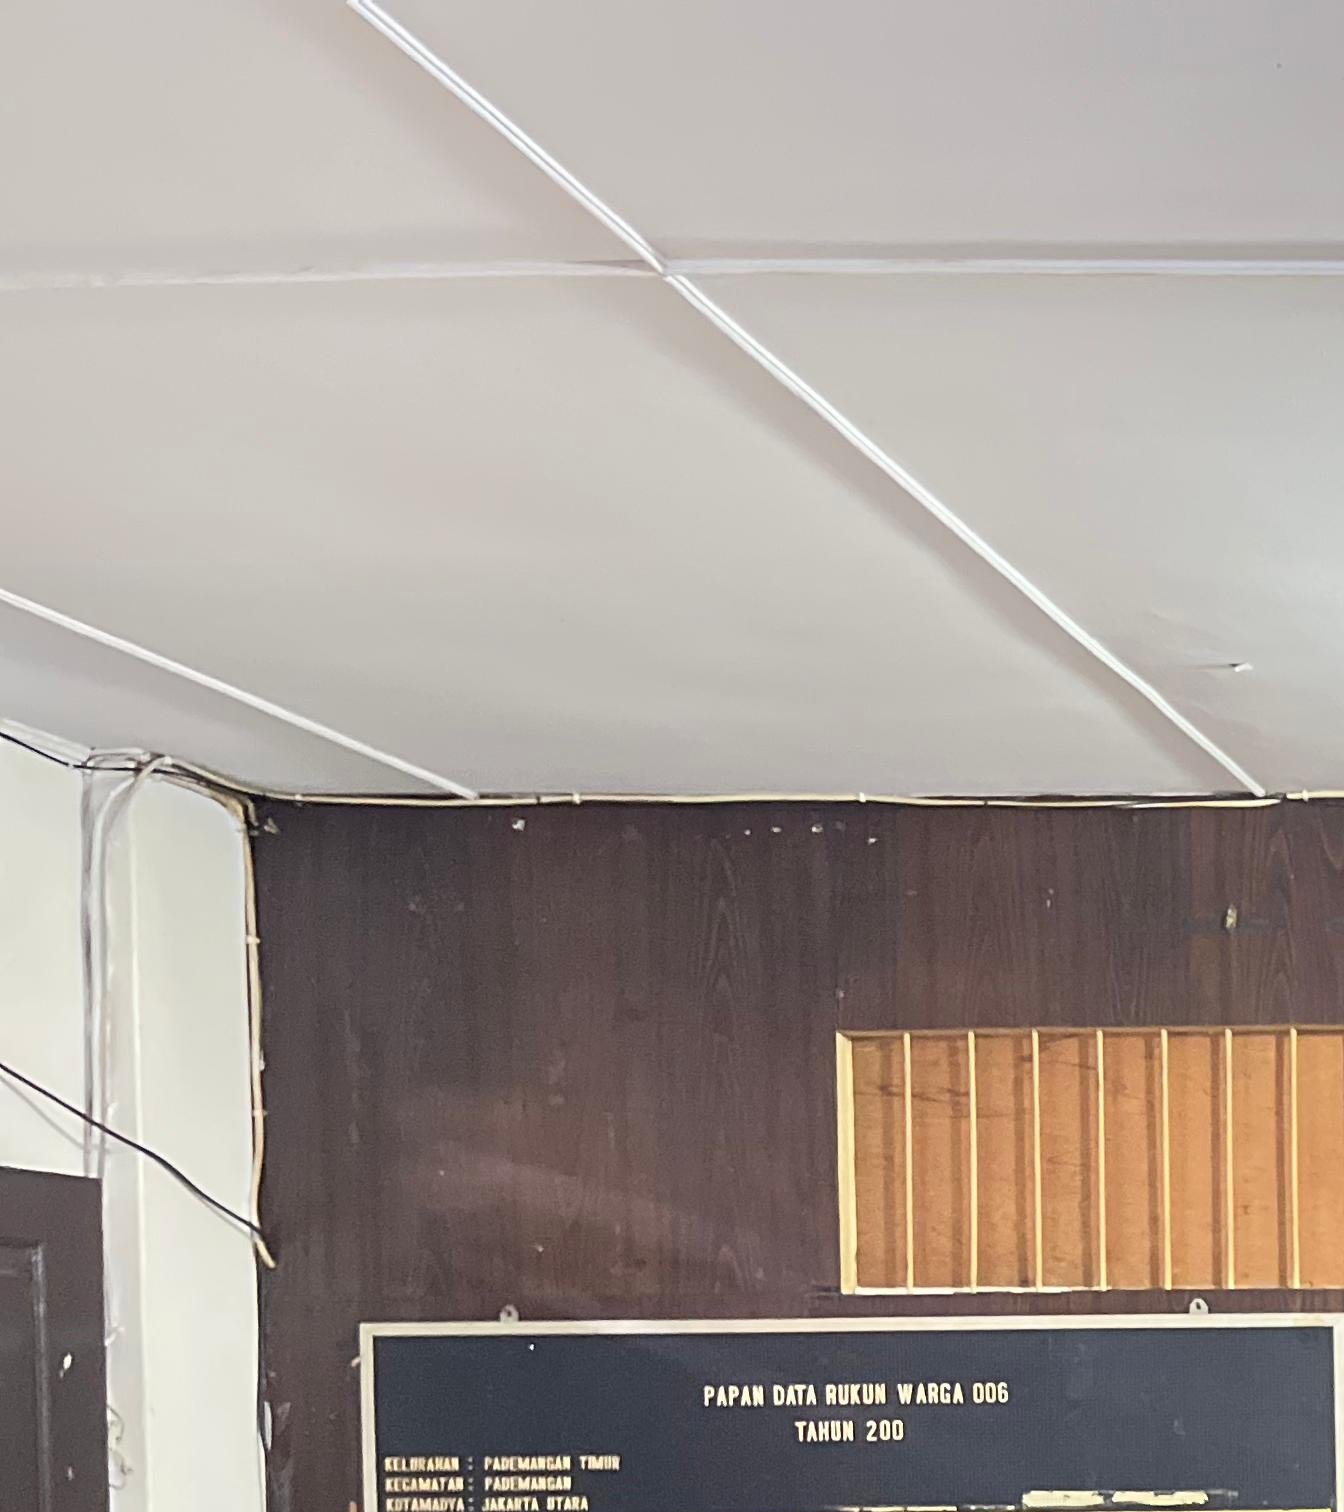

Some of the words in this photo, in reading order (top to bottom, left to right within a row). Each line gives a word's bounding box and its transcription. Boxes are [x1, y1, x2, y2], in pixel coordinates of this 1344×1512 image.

[704, 1384, 764, 1407] PAPAN
[773, 1384, 817, 1406] DATA
[825, 1383, 886, 1405] RUKUN
[897, 1383, 964, 1404] WARGA
[972, 1382, 1009, 1403] 006
[794, 1420, 854, 1442] TAHUN
[866, 1420, 904, 1441] 200
[385, 1456, 459, 1472] KELURAHAN
[484, 1455, 571, 1471] PADEMANGAN
[579, 1455, 621, 1471] TIMUR
[385, 1476, 464, 1492] KECAMATAN
[484, 1476, 572, 1491] PADEMANGAN
[386, 1497, 464, 1512] KOTAMADYA
[482, 1496, 539, 1512] JAKARTA
[547, 1496, 589, 1512] UTARA
